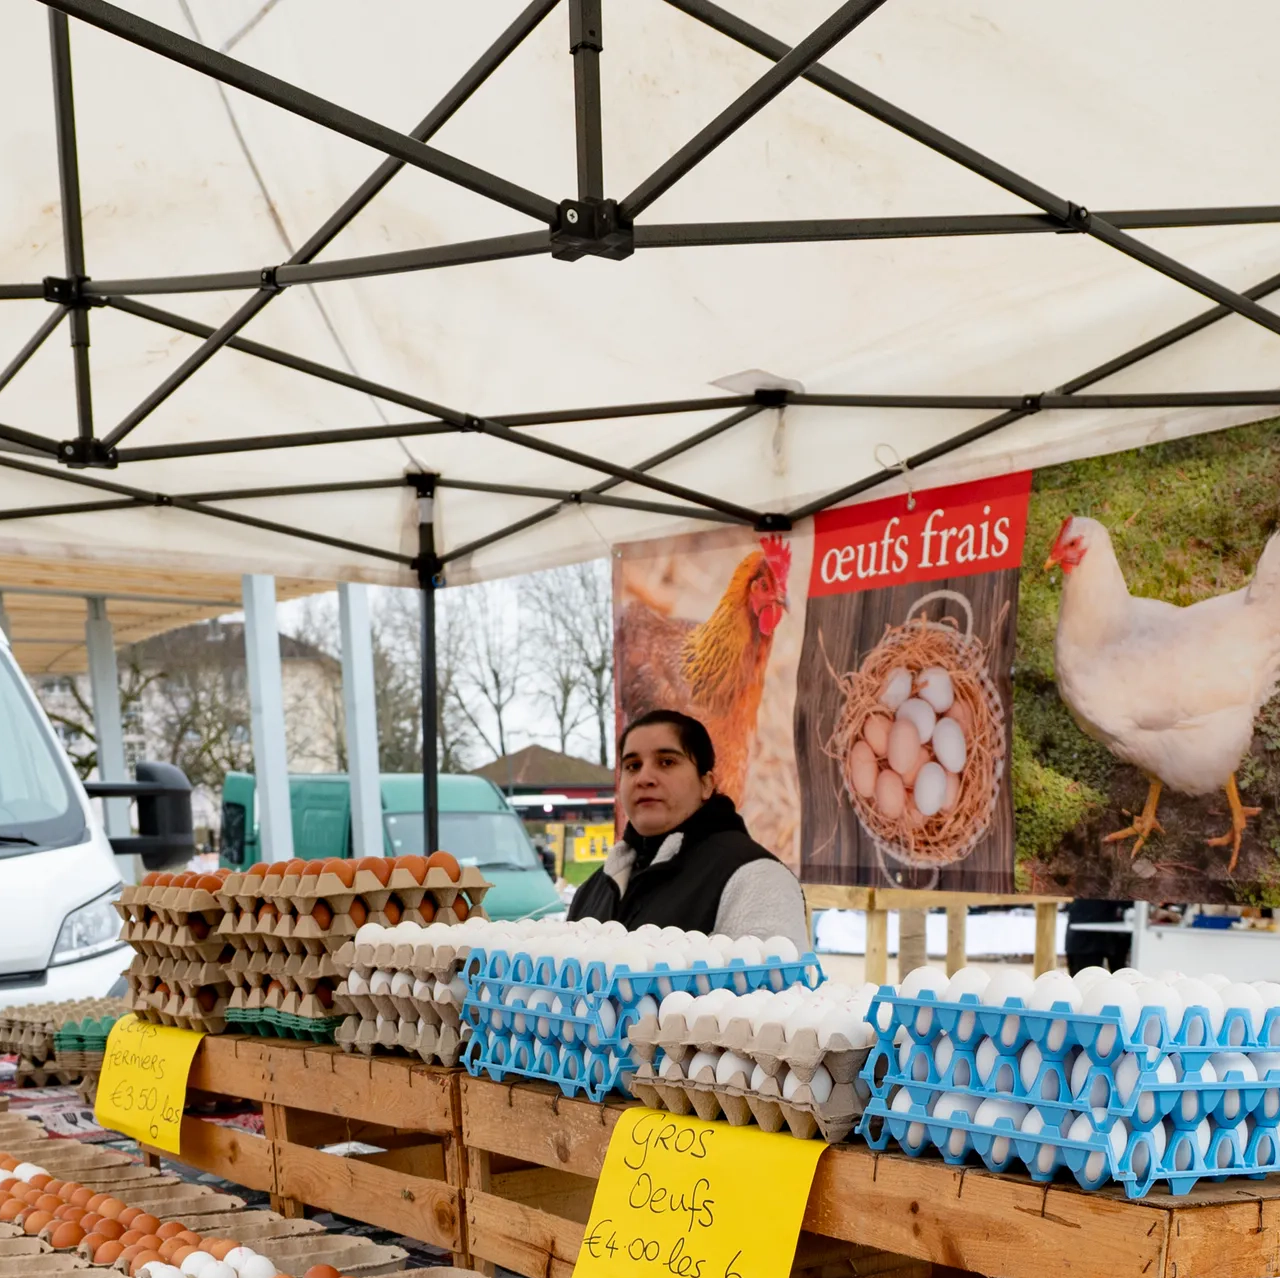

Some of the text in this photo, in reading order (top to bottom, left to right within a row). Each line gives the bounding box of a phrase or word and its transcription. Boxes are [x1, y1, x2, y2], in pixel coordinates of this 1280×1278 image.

[820, 504, 1011, 585] œufs frais
[623, 1112, 715, 1170] GROS
[628, 1172, 716, 1233] Oeufs
[662, 1236, 707, 1278] les
